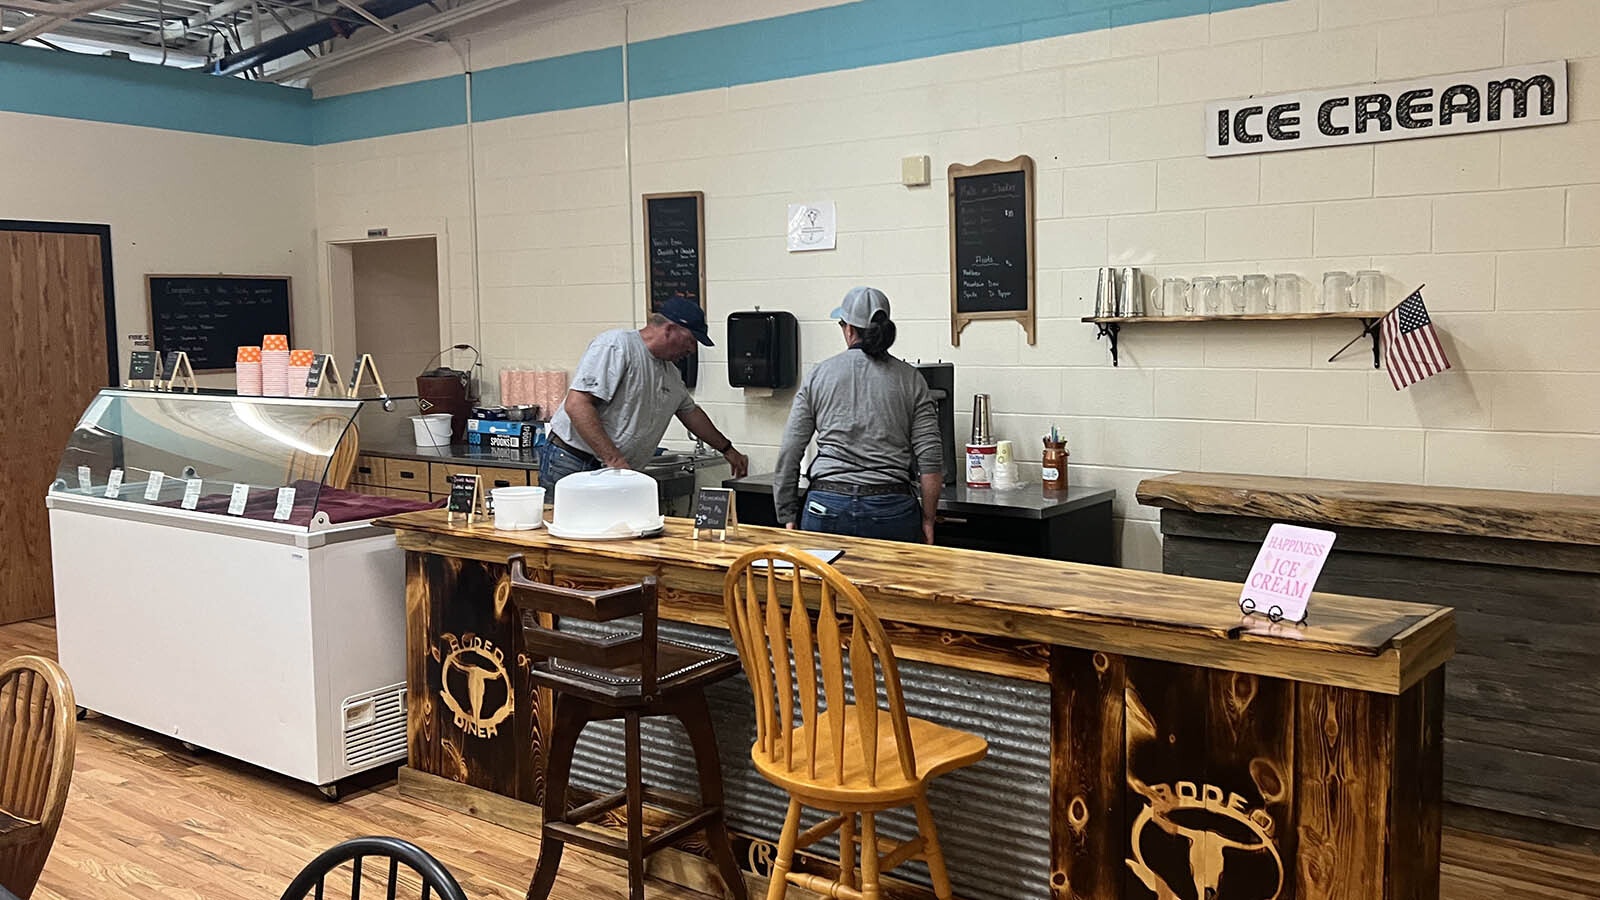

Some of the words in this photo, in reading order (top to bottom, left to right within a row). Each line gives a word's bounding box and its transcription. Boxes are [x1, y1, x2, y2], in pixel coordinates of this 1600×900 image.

[1218, 102, 1300, 146] ICE
[1317, 74, 1555, 136] CREAM
[490, 436, 512, 447] SPOONS
[1267, 536, 1326, 557] HAPPINESS
[1271, 558, 1301, 578] ICE
[1251, 572, 1309, 599] CREAM
[453, 716, 498, 739] DINER
[1149, 780, 1273, 833] RODEO
